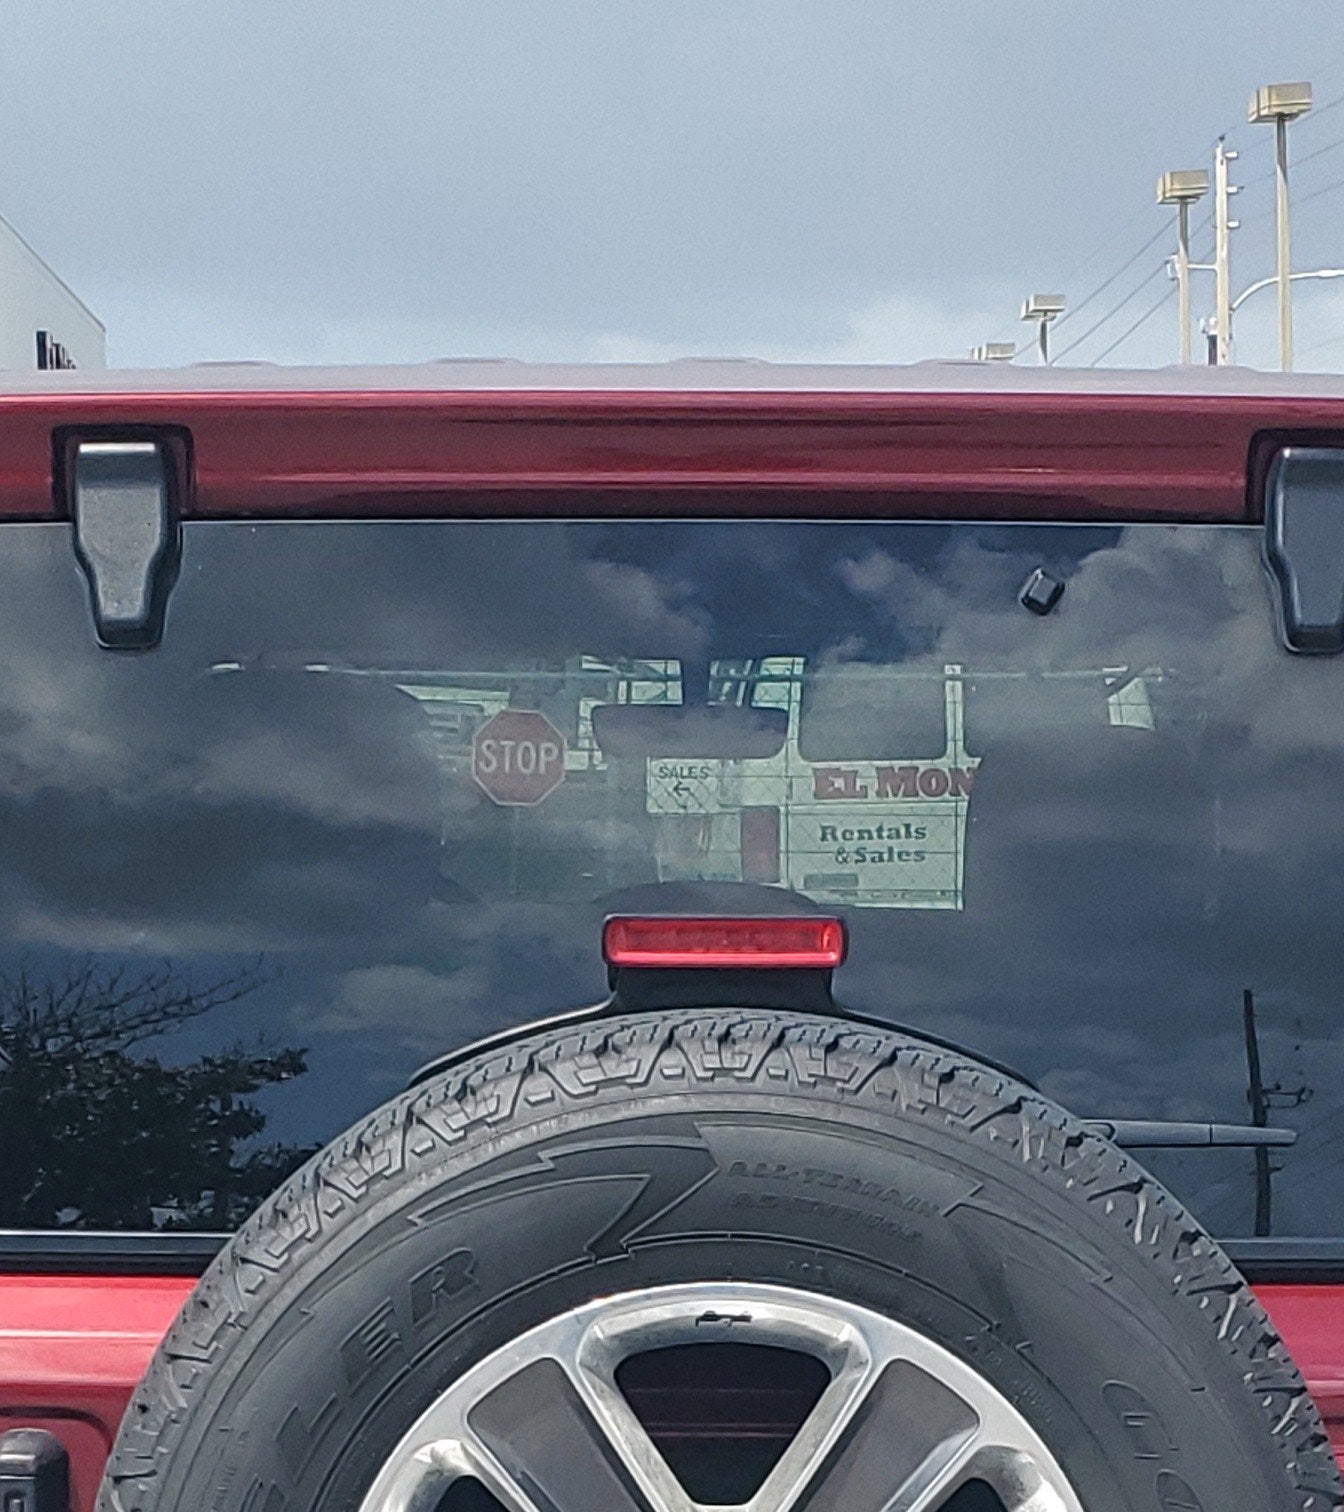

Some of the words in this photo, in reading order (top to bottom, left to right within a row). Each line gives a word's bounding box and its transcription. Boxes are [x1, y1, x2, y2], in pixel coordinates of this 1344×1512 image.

[479, 739, 558, 775] STOP
[658, 765, 711, 780] SALES
[812, 768, 868, 799] EL
[819, 823, 927, 842] Rentals
[835, 846, 926, 864] &Sales
